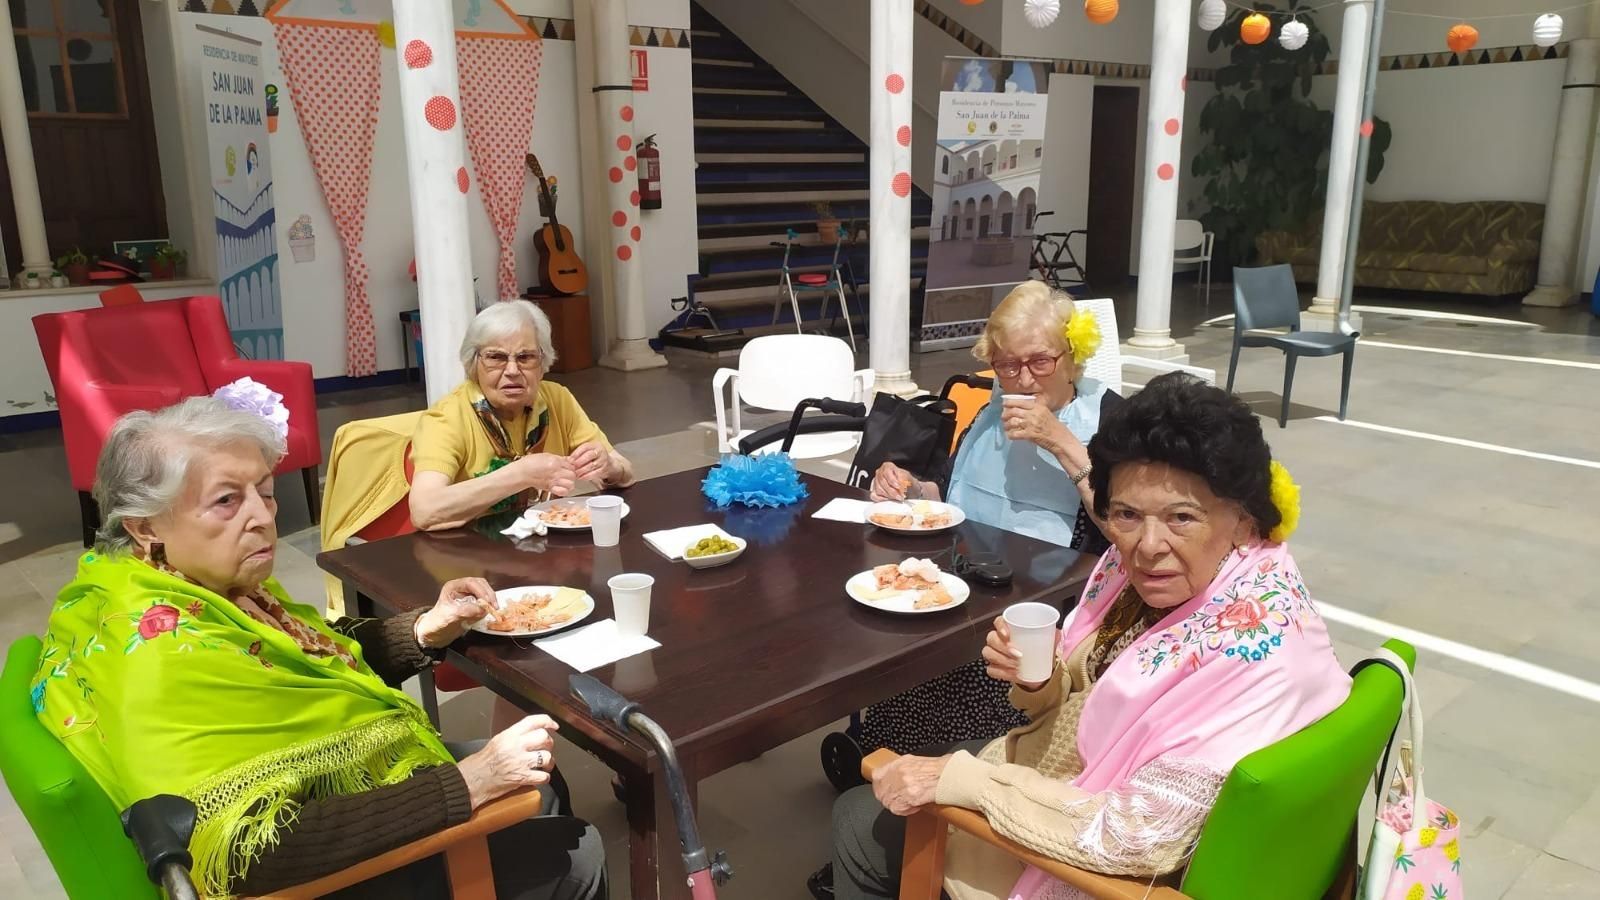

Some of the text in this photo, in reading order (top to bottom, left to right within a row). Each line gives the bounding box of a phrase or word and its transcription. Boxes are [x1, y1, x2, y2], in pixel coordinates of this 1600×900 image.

[213, 71, 254, 96] SAN JUAN
[209, 103, 262, 126] DE LA PALMA
[956, 110, 1030, 120] San Juan de la Palma
